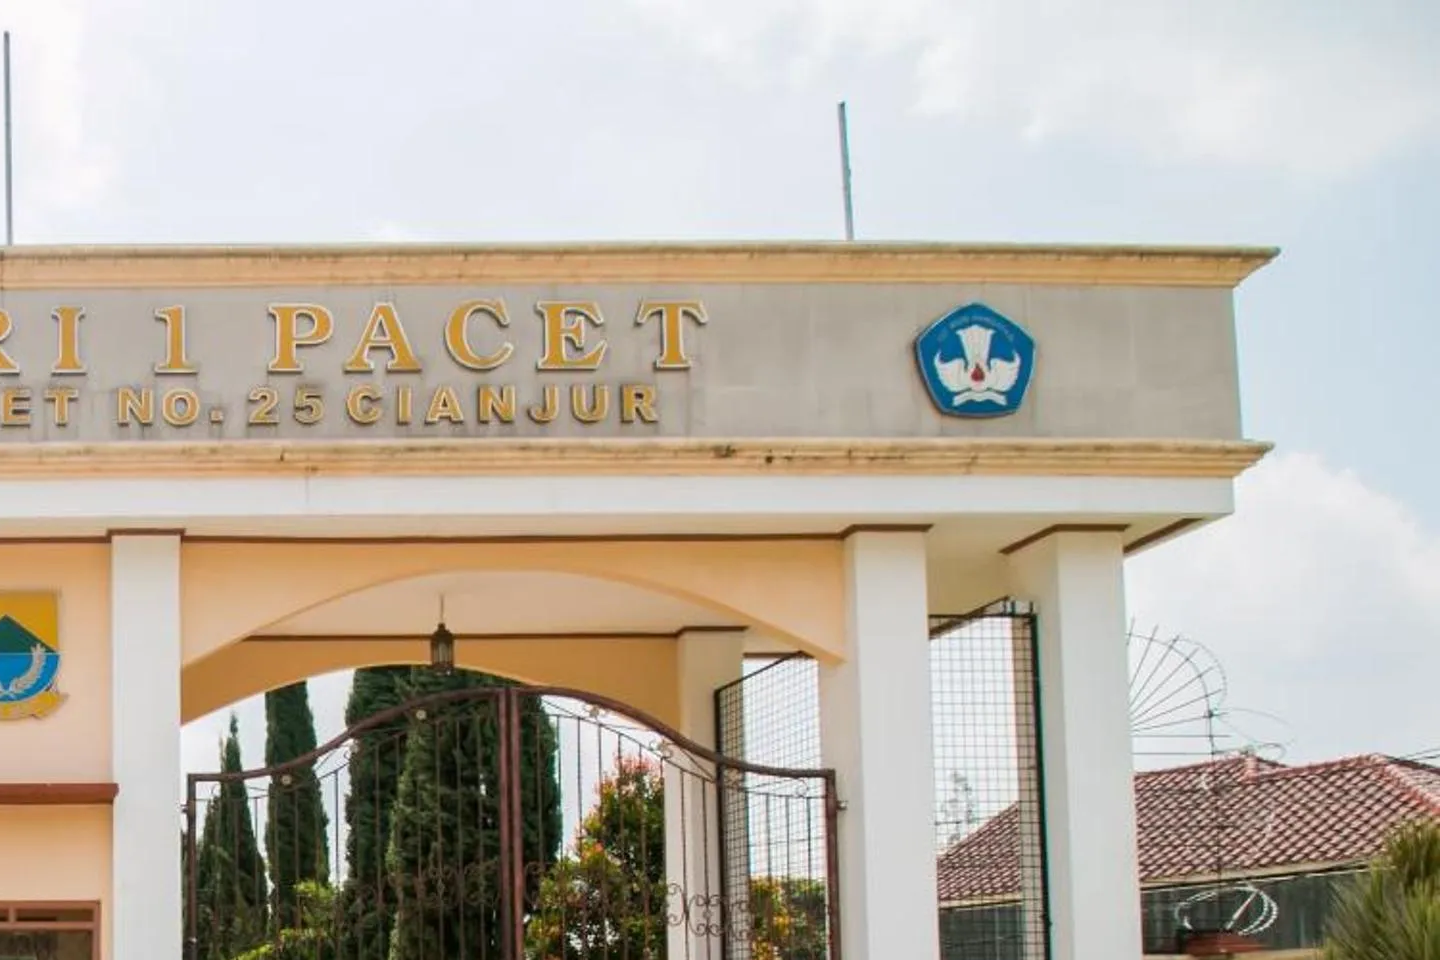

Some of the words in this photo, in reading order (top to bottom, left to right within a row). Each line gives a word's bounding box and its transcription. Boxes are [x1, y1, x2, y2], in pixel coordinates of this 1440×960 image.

[154, 304, 198, 375] 1
[268, 299, 708, 373] PACET
[117, 388, 223, 427] NO.
[248, 386, 326, 425] 25
[346, 384, 658, 425] CIANJUR
